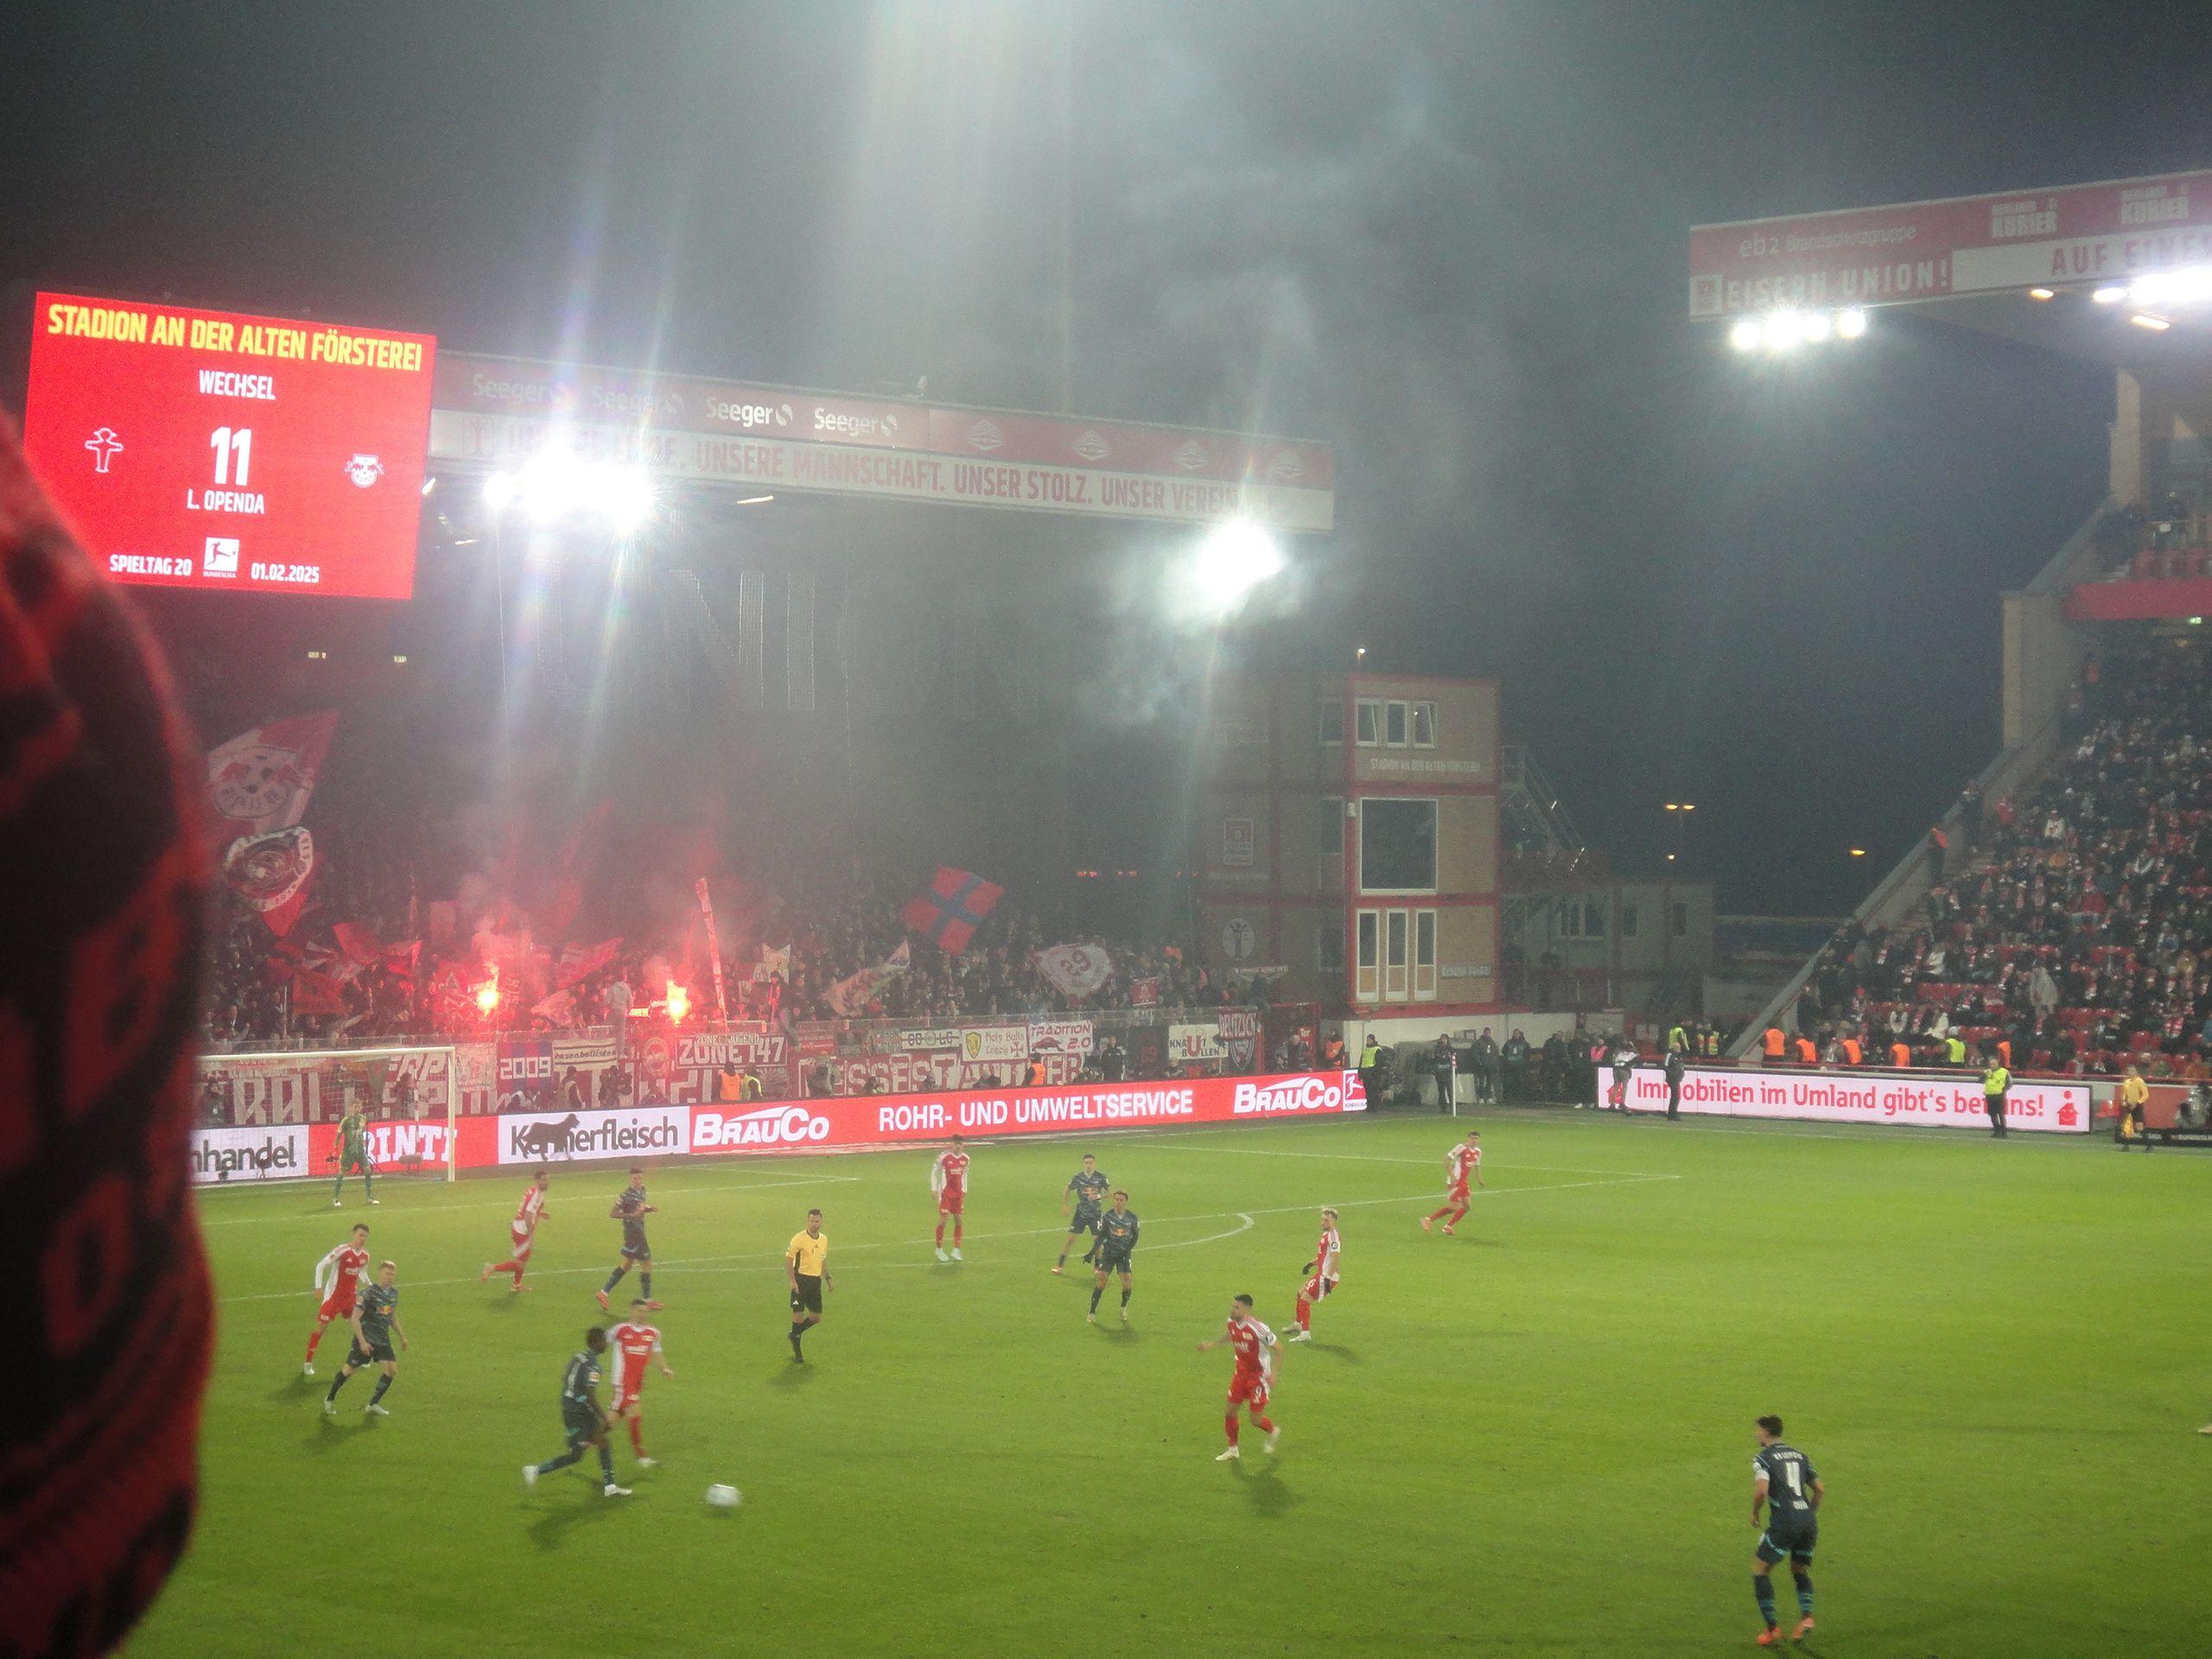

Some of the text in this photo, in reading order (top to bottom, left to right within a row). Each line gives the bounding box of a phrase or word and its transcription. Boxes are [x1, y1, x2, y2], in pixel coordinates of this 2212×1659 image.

[2050, 243, 2108, 276] AUF
[1839, 258, 1948, 296] UNION!
[47, 303, 423, 372] STADION AN DER ALTEN FÖRSTEREI
[199, 369, 276, 400] WECHSEL
[705, 397, 773, 428] Seeger
[814, 407, 878, 436] Seeger
[211, 427, 252, 486] 11
[696, 442, 784, 478] UNSERE
[792, 451, 945, 493] MANNSCHAFT.
[954, 464, 1021, 501] UNSER
[1027, 470, 1093, 505] STOLZ.
[1102, 477, 1165, 512] UNSER
[187, 489, 264, 514] L. OPENDA
[110, 554, 193, 576] SPIELTAG 20
[251, 562, 320, 583] 01.02.2025
[1030, 1024, 1091, 1039] TRADITION
[1300, 1028, 1310, 1037] Tor
[678, 1039, 741, 1065] ZONE
[748, 1037, 785, 1063] 147
[499, 1056, 551, 1080] 2009
[1637, 1077, 1753, 1103] Imobilien
[1760, 1080, 1787, 1105] im
[1793, 1083, 1877, 1109] Umland
[879, 1090, 1193, 1132] ROHR- UND UMWELTSERVICE
[511, 1116, 678, 1156] Knerfleisch
